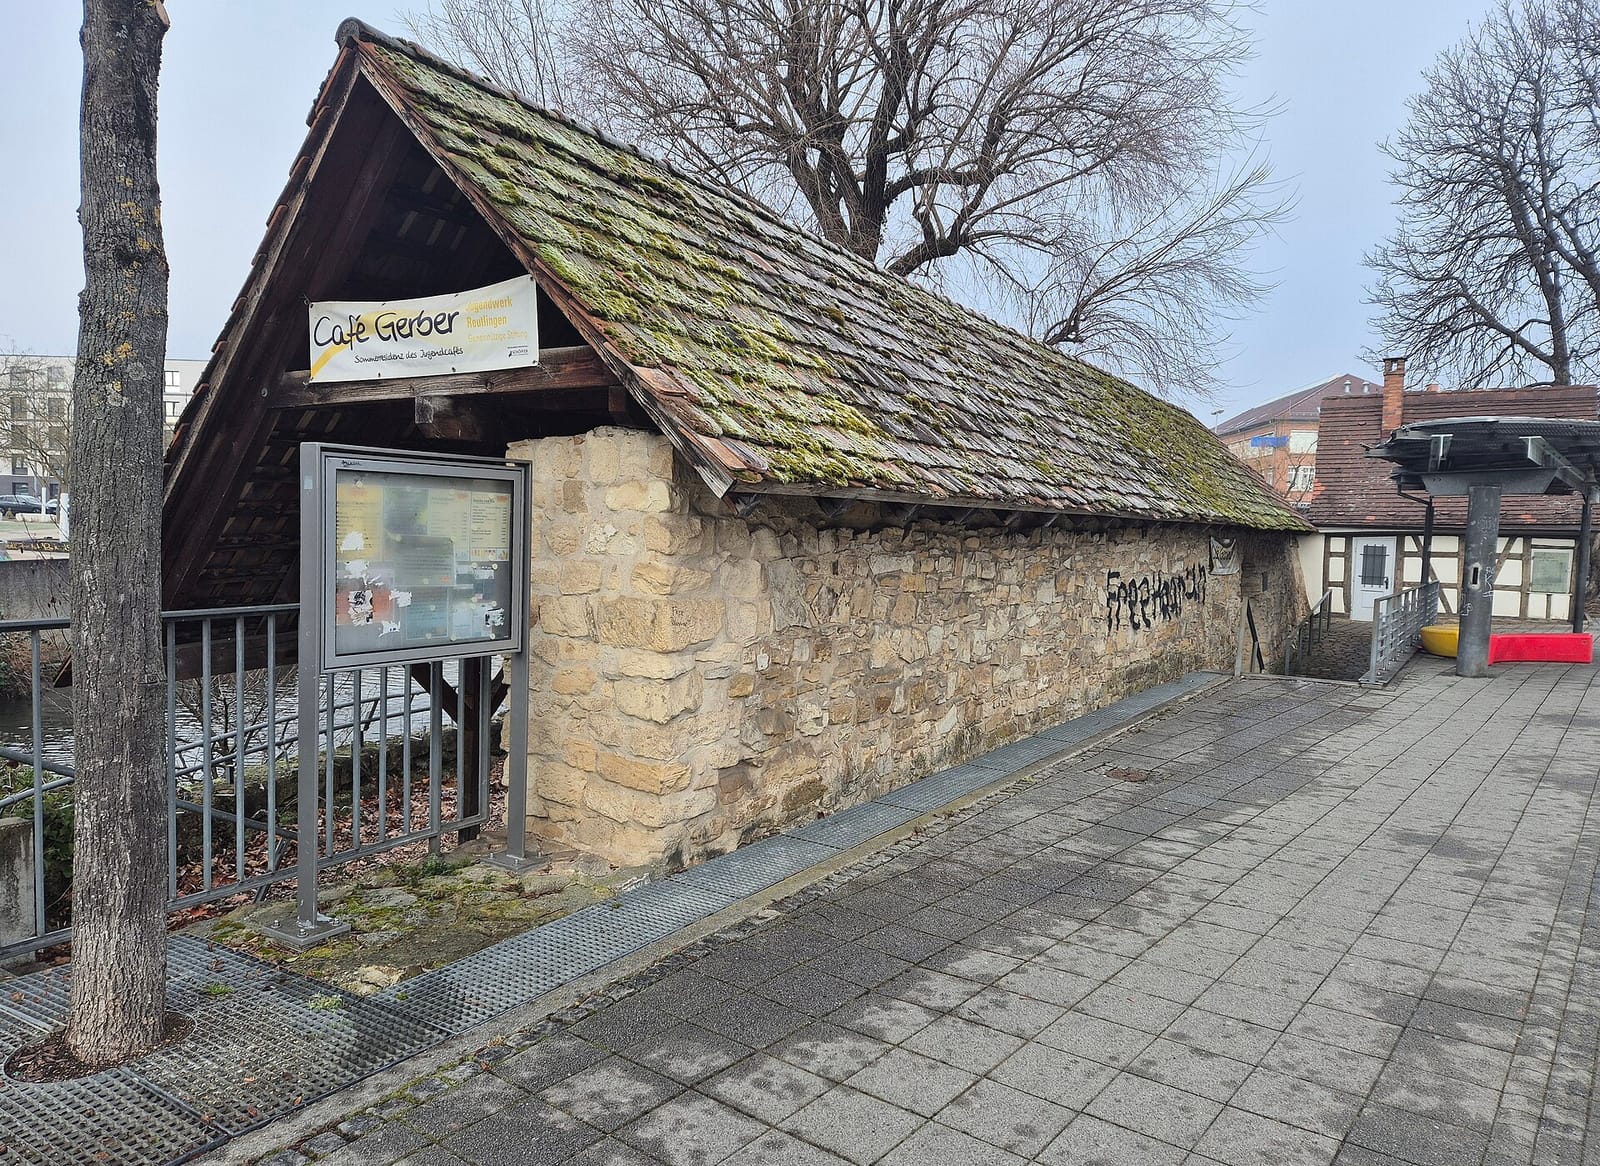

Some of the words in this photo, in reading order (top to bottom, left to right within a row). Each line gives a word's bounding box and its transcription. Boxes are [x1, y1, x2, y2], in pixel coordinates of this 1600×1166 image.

[466, 314, 508, 329] Reutlingen
[313, 314, 370, 351] Café
[374, 310, 460, 342] Gerber
[405, 351, 418, 360] des
